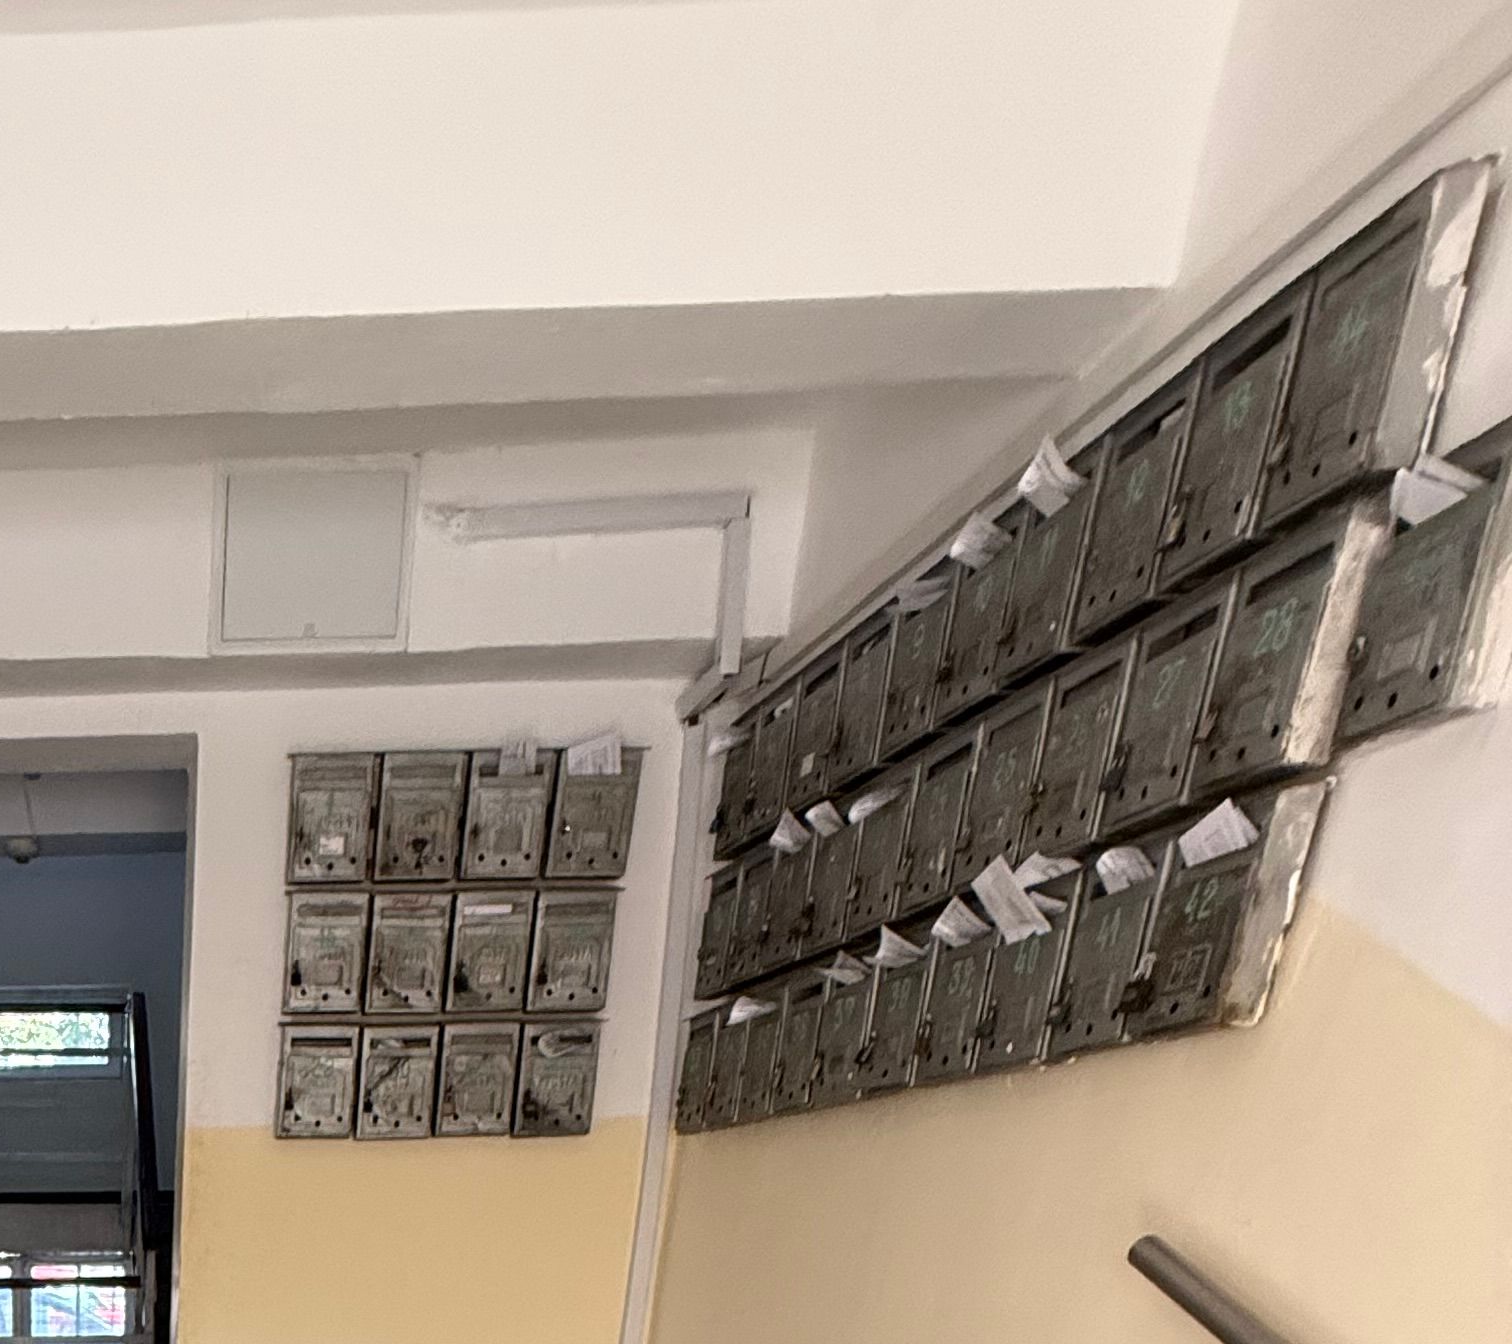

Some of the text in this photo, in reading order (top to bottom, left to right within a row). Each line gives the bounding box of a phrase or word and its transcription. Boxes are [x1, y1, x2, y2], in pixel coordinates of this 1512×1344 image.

[1253, 597, 1299, 658] 28
[1185, 876, 1220, 922] 42
[1095, 906, 1122, 952] 41
[1014, 939, 1040, 975] 40
